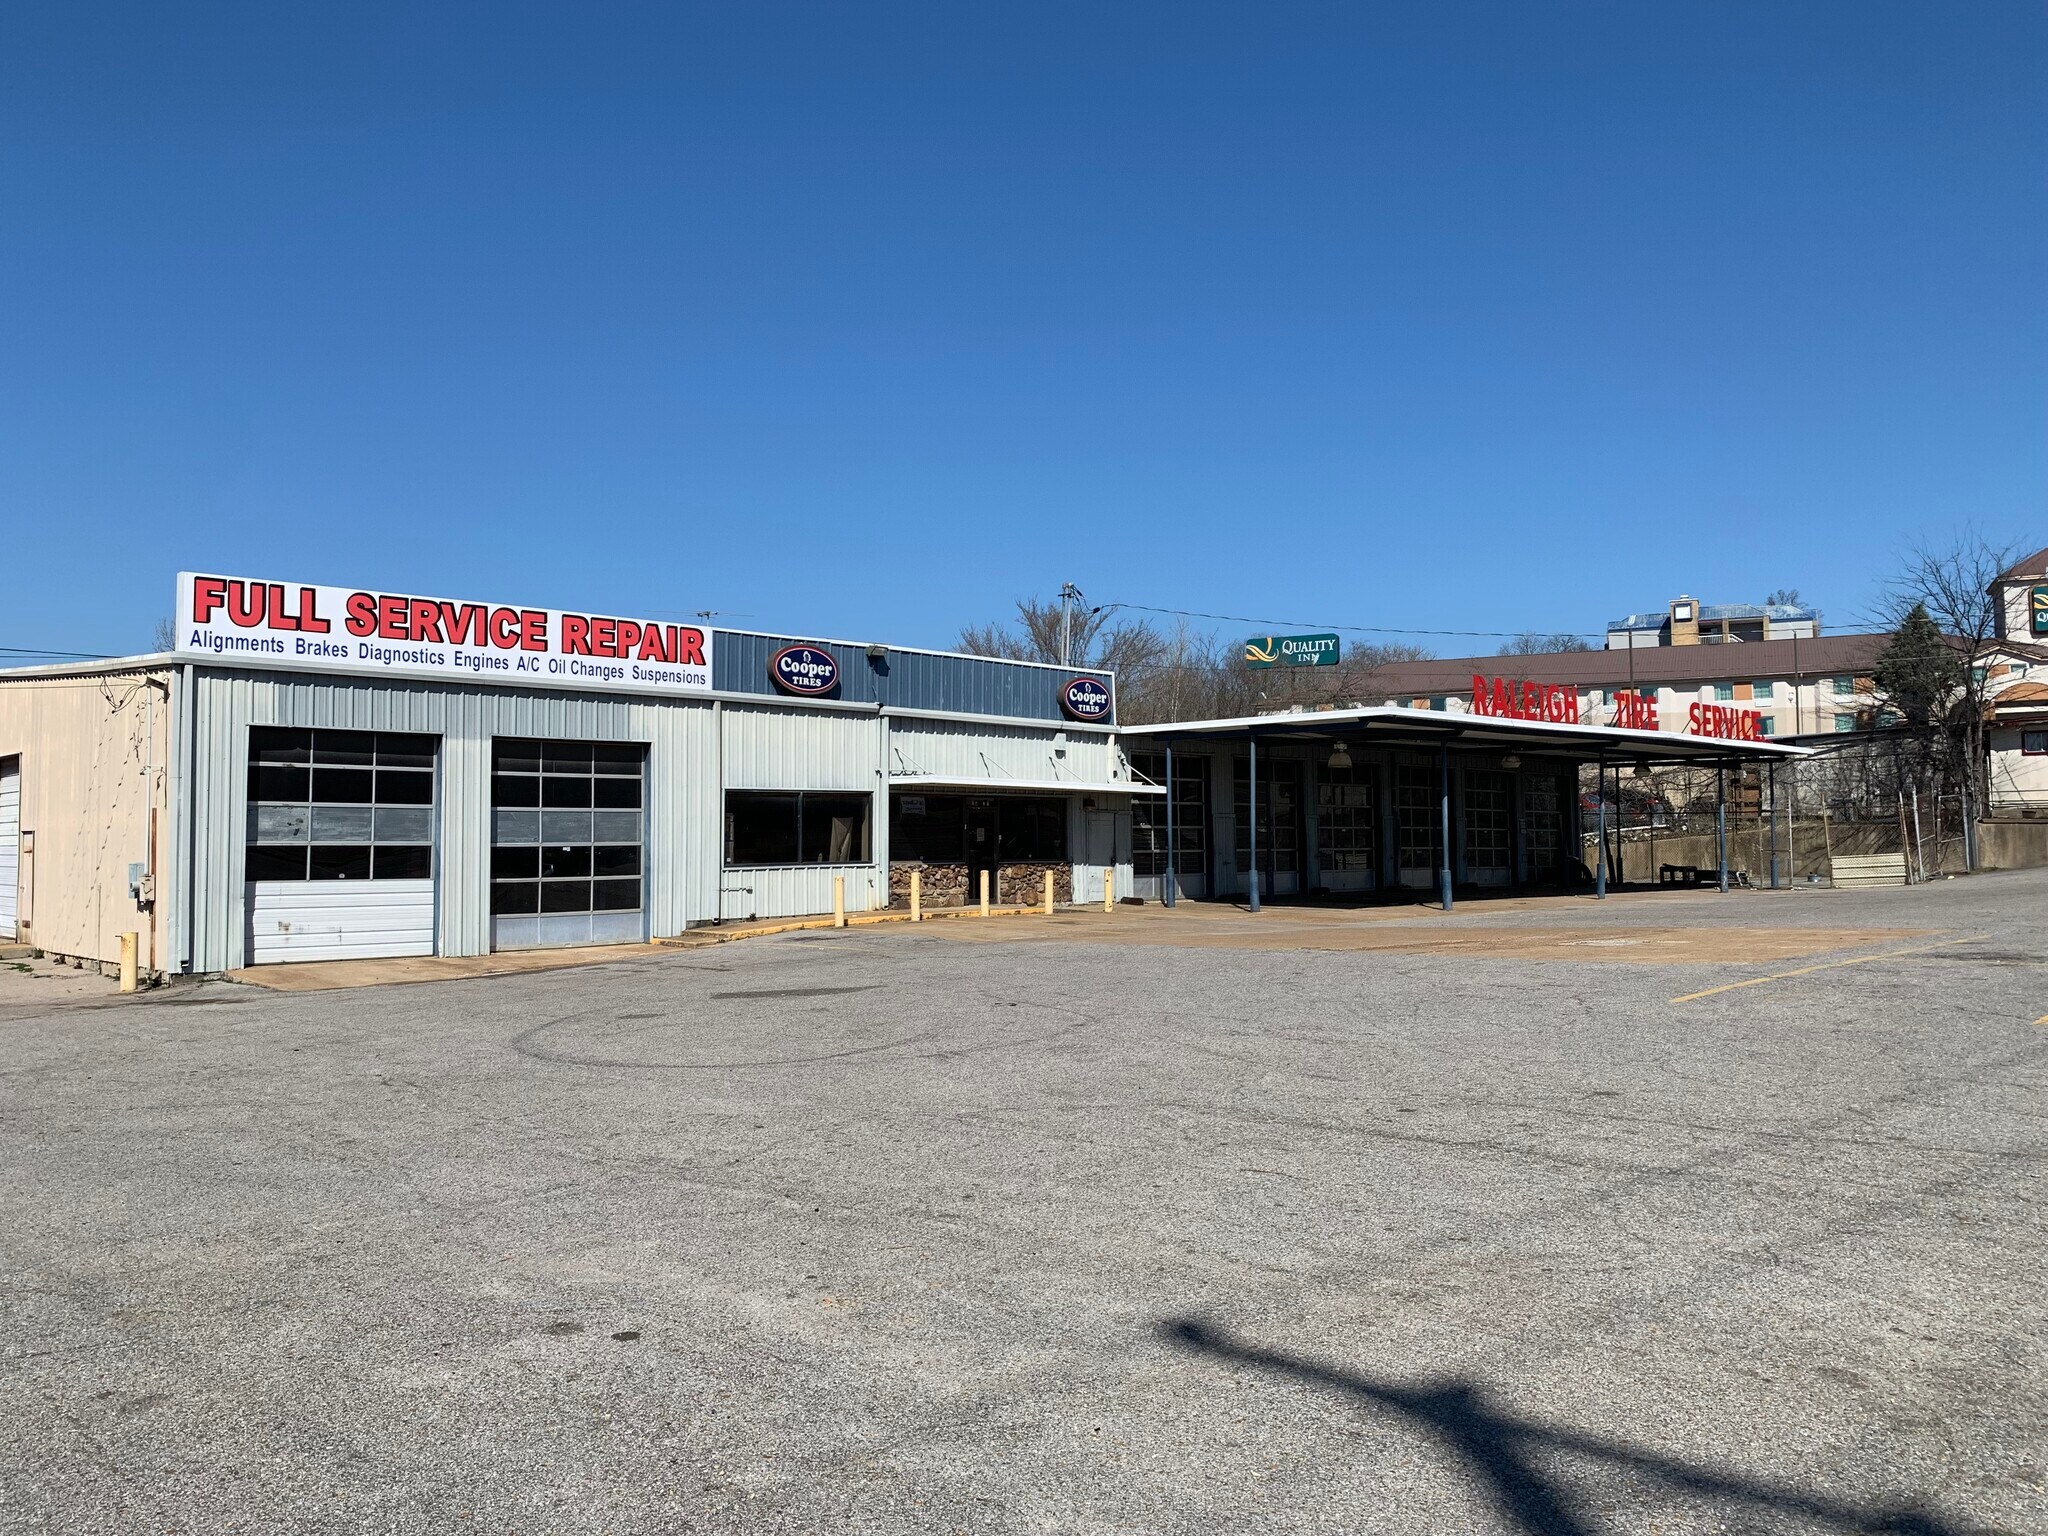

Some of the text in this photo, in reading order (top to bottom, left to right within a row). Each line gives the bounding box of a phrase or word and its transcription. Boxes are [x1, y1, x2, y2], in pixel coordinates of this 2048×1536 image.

[193, 576, 706, 666] FULL SERVICE REPAIR
[1282, 639, 1336, 655] QUALITY
[190, 629, 706, 685] Alignments Brakes Diagnostics Engines A/C Oil Changes Suspensions
[1298, 652, 1320, 663] INN
[780, 656, 833, 678] Cooper
[792, 676, 822, 687] TIRES
[1069, 687, 1108, 706] Cooper
[1077, 704, 1100, 713] TIRES
[1473, 674, 1763, 742] RALEIGH TIRE SERVICE
